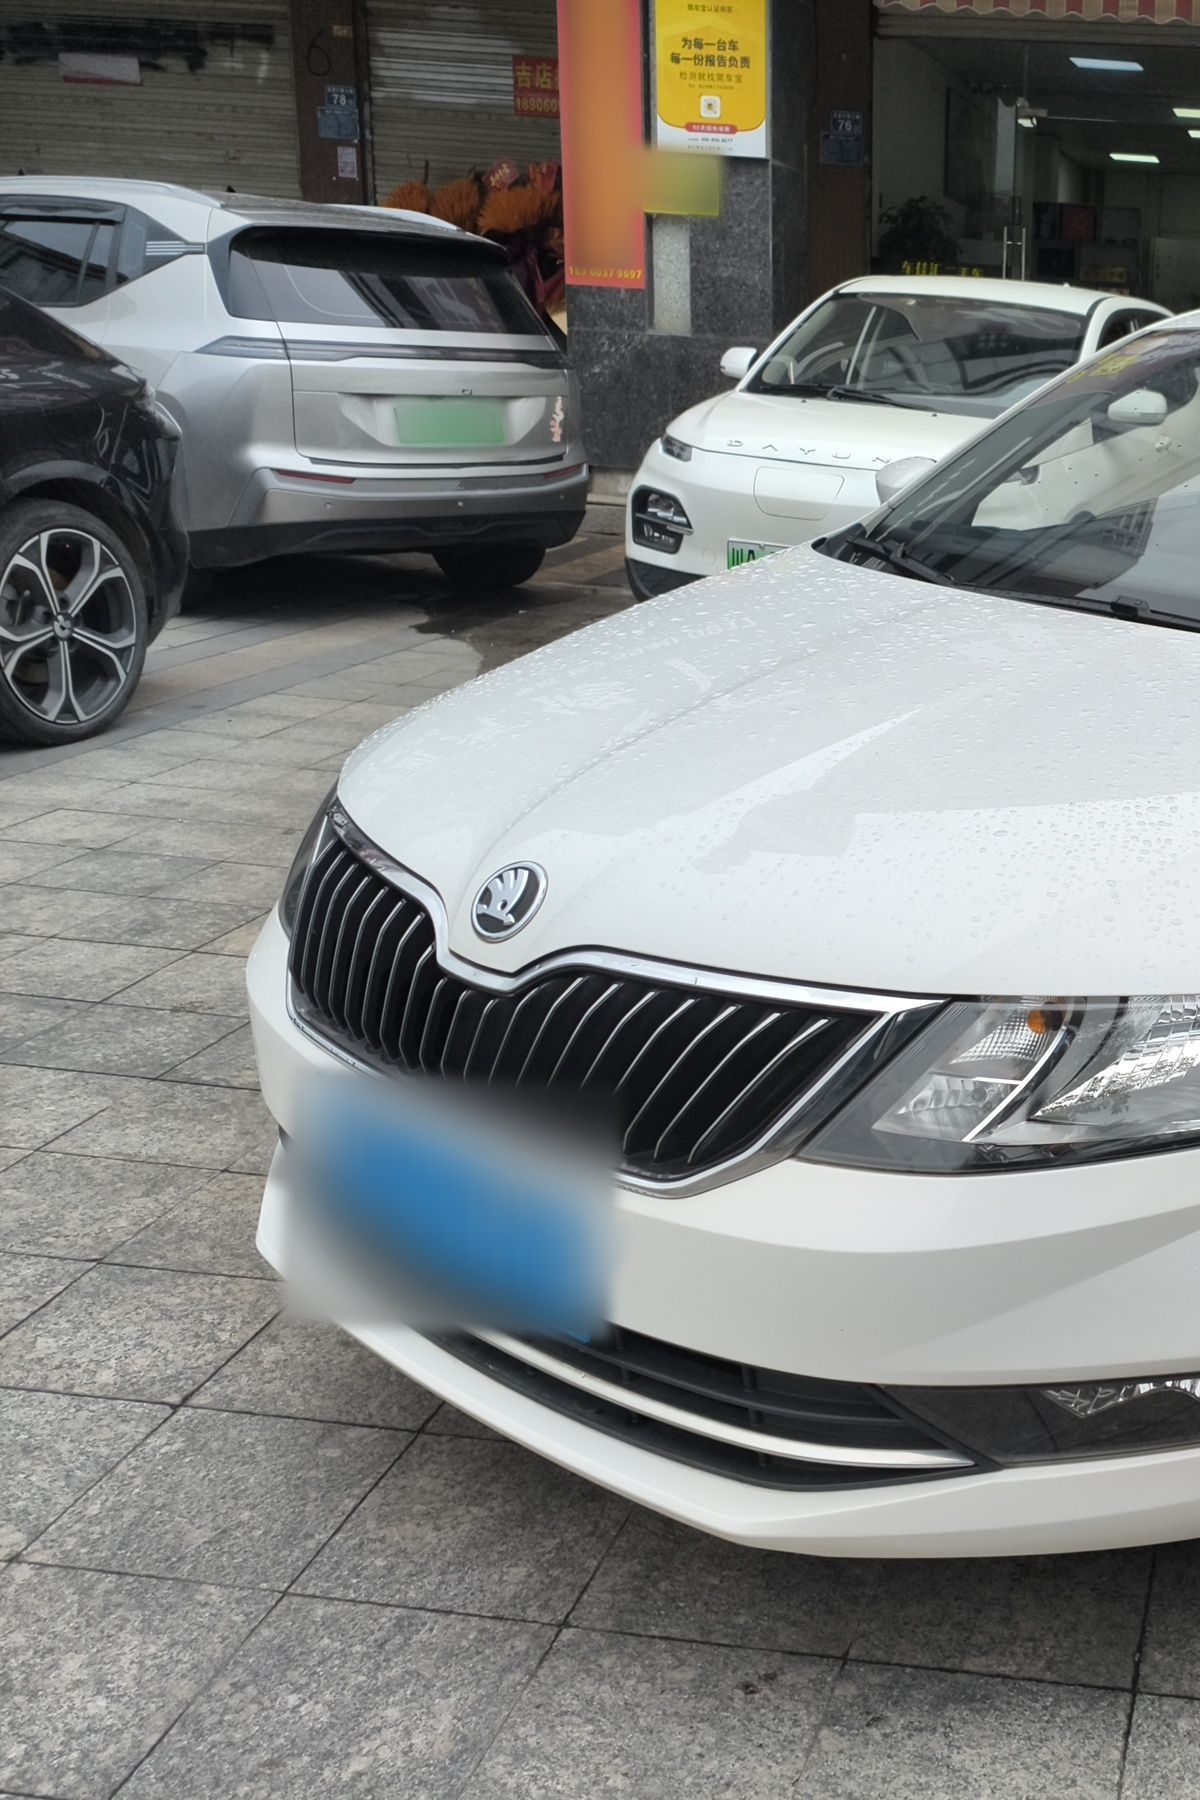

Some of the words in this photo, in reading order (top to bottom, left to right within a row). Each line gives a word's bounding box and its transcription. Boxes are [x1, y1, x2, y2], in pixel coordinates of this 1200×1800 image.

[681, 37, 740, 52] 为每一台车
[670, 52, 751, 69] 每一份报告负责
[516, 96, 561, 112] 189060
[727, 439, 891, 464] DAYUN
